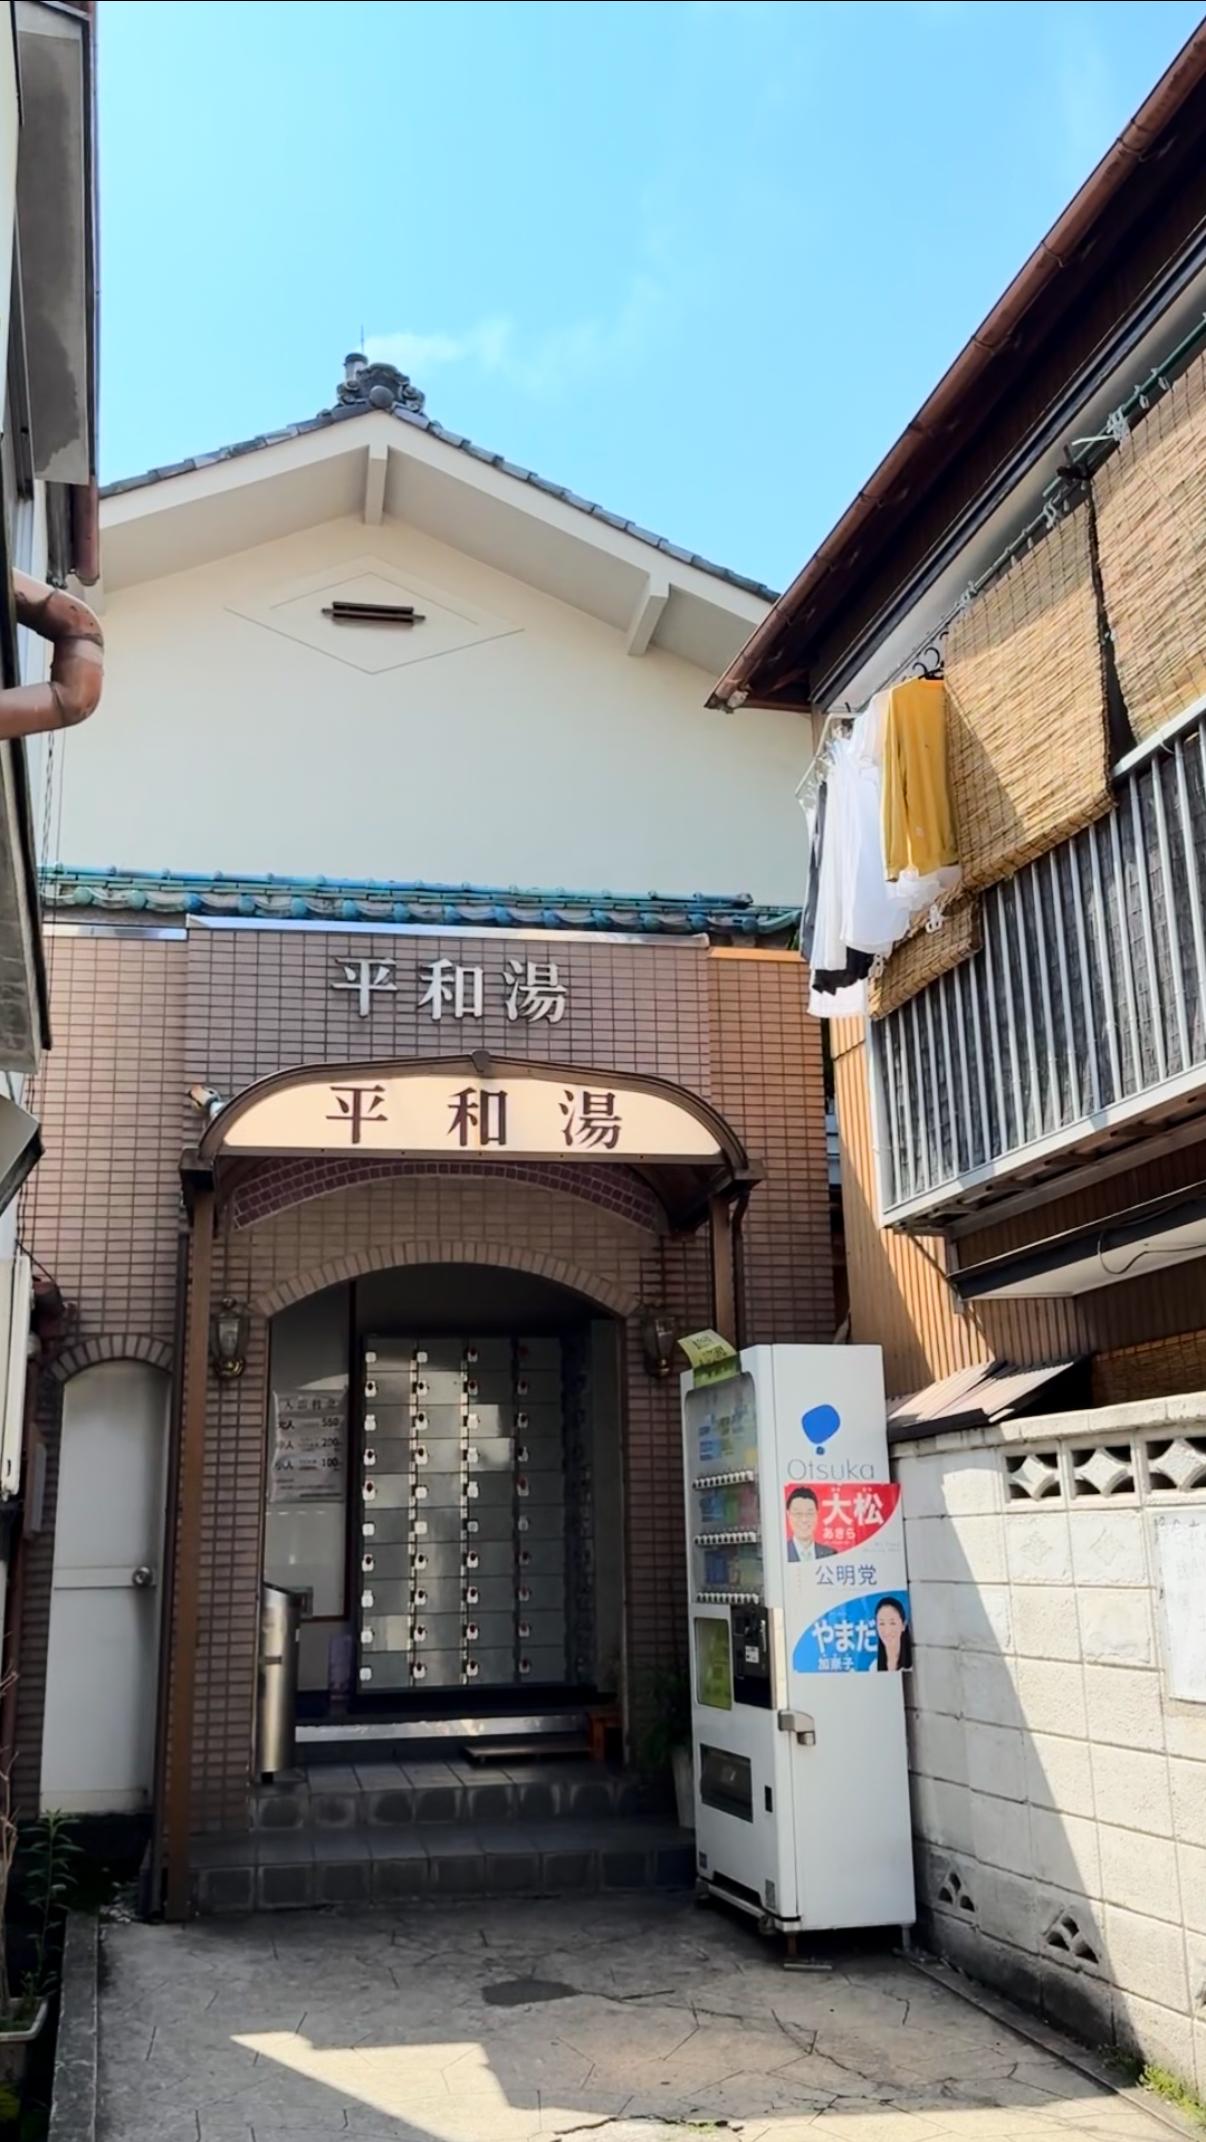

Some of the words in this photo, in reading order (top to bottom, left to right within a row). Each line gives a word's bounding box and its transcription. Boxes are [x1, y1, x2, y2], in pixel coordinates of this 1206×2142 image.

[331, 957, 568, 1023] 平和湯
[326, 1084, 622, 1149] 平和湯
[787, 1458, 875, 1480] Otsuka
[821, 1491, 885, 1526] 大松
[823, 1527, 856, 1540] あきら
[815, 1563, 877, 1586] 公明党
[811, 1618, 878, 1654] やまだ
